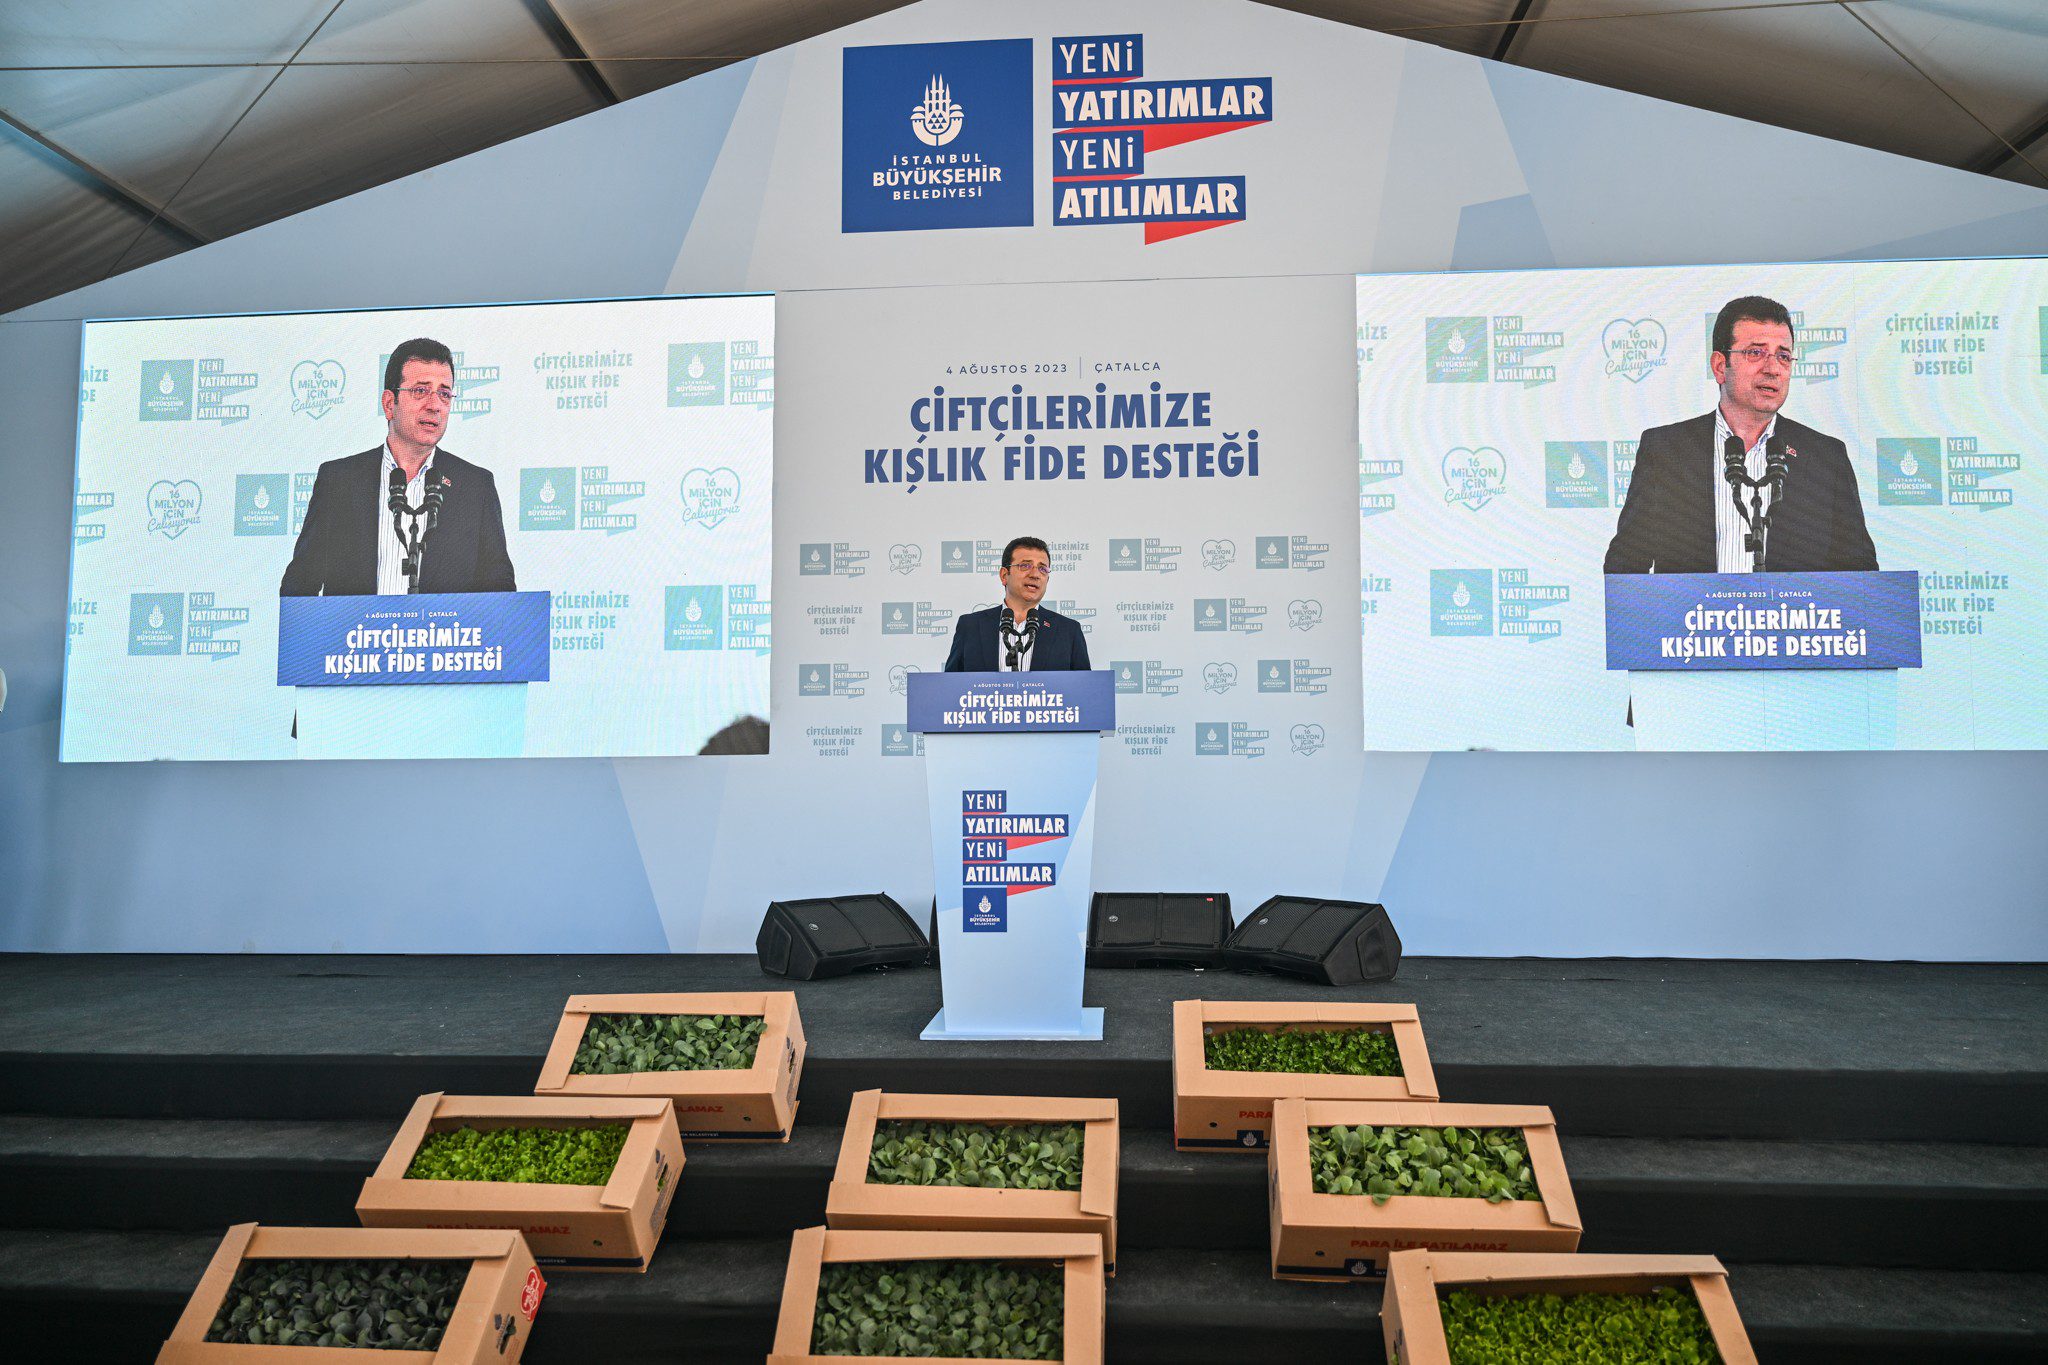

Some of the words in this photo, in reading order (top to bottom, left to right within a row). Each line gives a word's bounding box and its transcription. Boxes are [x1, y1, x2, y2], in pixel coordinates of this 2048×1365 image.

[1060, 40, 1133, 74] YENİ
[1059, 84, 1264, 122] YATIRIMLAR
[893, 153, 981, 165] İSTANBUL
[1060, 136, 1134, 170] YENİ
[873, 166, 1001, 187] BÜYÜKŞEHİR
[893, 186, 982, 199] BELEDİYESİ
[1059, 183, 1239, 219] ATILIMLAR
[1495, 318, 1520, 329] YENİ
[1886, 311, 1998, 336] ÇİFTÇİLERİMİZE
[1628, 330, 1640, 338] 16
[1496, 335, 1562, 346] YATIRIMLAR
[1612, 340, 1657, 349] MİLYON
[1901, 339, 1947, 357] KIŞLIK
[1954, 334, 1985, 352] FİDE
[733, 343, 755, 353] YENİ
[1496, 351, 1520, 363] YENİ
[1622, 350, 1647, 360] İÇİN
[201, 359, 221, 372] YENİ
[534, 350, 632, 374] ÇİFTÇİLERİMİZE
[1095, 361, 1161, 374] ÇATALCA
[1605, 357, 1667, 378] Çalışıyoruz
[1914, 356, 1972, 375] DESTEĞİ
[946, 366, 953, 375] 4
[959, 362, 1028, 374] AĞUSTOS
[1034, 364, 1067, 373] 2023
[1496, 369, 1553, 380] ATILIMLAR
[200, 375, 256, 387] YATIRIMLAR
[313, 371, 323, 379] 16
[733, 375, 755, 387] YENİ
[299, 380, 338, 388] MİLYON
[546, 375, 586, 393] KIŞLIK
[592, 371, 619, 387] FİDE
[200, 392, 221, 403] YENİ
[308, 390, 328, 399] İÇİN
[557, 391, 608, 409] DESTEĞİ
[200, 407, 248, 418] ATILIMLAR
[910, 381, 1211, 443] ÇİFTÇİLERİMİZE
[1950, 439, 1975, 451] YENİ
[865, 447, 986, 493] KIŞLIK
[1004, 434, 1085, 481] FİDE
[1104, 429, 1259, 479] DESTEĞİ
[1468, 458, 1479, 466] 16
[1950, 457, 2017, 468] YATIRIMLAR
[584, 468, 606, 480] YENİ
[1451, 468, 1497, 477] MİLYON
[706, 478, 716, 486] 16
[1462, 478, 1486, 489] İÇİN
[1951, 474, 1975, 485] YENİ
[169, 490, 179, 499] 16
[583, 484, 643, 496] YATIRIMLAR
[689, 488, 731, 497] MİLYON
[1444, 485, 1506, 506] Çalışıyoruz
[699, 498, 721, 507] İÇİN
[1951, 492, 2010, 503] ATILIMLAR
[155, 500, 194, 509] MİLYON
[584, 500, 605, 512] YENİ
[164, 510, 184, 518] İÇİN
[683, 506, 740, 526] Çalışıyoruz
[583, 517, 634, 528] ATILIMLAR
[1502, 570, 1526, 583] YENİ
[731, 587, 754, 598] YENİ
[1501, 588, 1567, 599] YATIRIMLAR
[192, 594, 212, 605] YENİ
[1964, 593, 1994, 612] FİDE
[807, 605, 862, 616] ÇİFTÇİLERİMİZE
[1117, 601, 1173, 613] ÇİFTÇİLERİMİZE
[1502, 604, 1526, 617] YENİ
[191, 610, 246, 621] YATIRIMLAR
[588, 612, 616, 629] FİDE
[814, 618, 836, 626] KIŞLIK
[840, 616, 855, 624] FİDE
[1124, 614, 1148, 623] KIŞLIK
[1151, 612, 1166, 620] FİDE
[1685, 603, 1841, 637] ÇİFTÇİLERİMİZE
[730, 619, 753, 631] YENİ
[820, 626, 848, 635] DESTEĞİ
[1131, 623, 1160, 631] DESTEĞİ
[1502, 622, 1558, 634] ATILIMLAR
[1924, 615, 1982, 634] DESTEĞİ
[190, 626, 210, 637] YENİ
[347, 622, 481, 654] ÇİFTÇİLERİMİZE
[553, 633, 604, 650] DESTEĞİ
[188, 642, 238, 653] ATILIMLAR
[1662, 637, 1726, 663] KIŞLIK
[1734, 630, 1777, 656] FİDE
[1786, 629, 1866, 656] DESTEĞİ
[325, 654, 381, 679] KIŞLIK
[388, 648, 425, 672] FİDE
[432, 646, 502, 671] DESTEĞİ
[960, 690, 1063, 711] ÇİFTÇİLERİMİZE
[944, 712, 986, 728] KIŞLIK
[992, 707, 1020, 723] FİDE
[1026, 706, 1079, 723] DESTEĞİ
[806, 726, 862, 737] ÇİFTÇİLERİMİZE
[1118, 725, 1175, 736] ÇİFTÇİLERİMİZE
[814, 739, 836, 747] KIŞLIK
[840, 737, 854, 745] FİDE
[1125, 738, 1148, 746] KIŞLIK
[1152, 736, 1168, 744] FİDE
[820, 747, 848, 756] DESTEĞİ
[1132, 746, 1161, 755] DESTEĞİ
[966, 794, 1002, 809] YENİ
[966, 818, 1065, 833] YATIRIMLAR
[966, 842, 1002, 858] YENİ
[966, 867, 1052, 882] ATILIMLAR
[1351, 1240, 1390, 1248] PARA
[1394, 1239, 1415, 1249] İLE
[1420, 1241, 1508, 1250] SATILAMAZ
